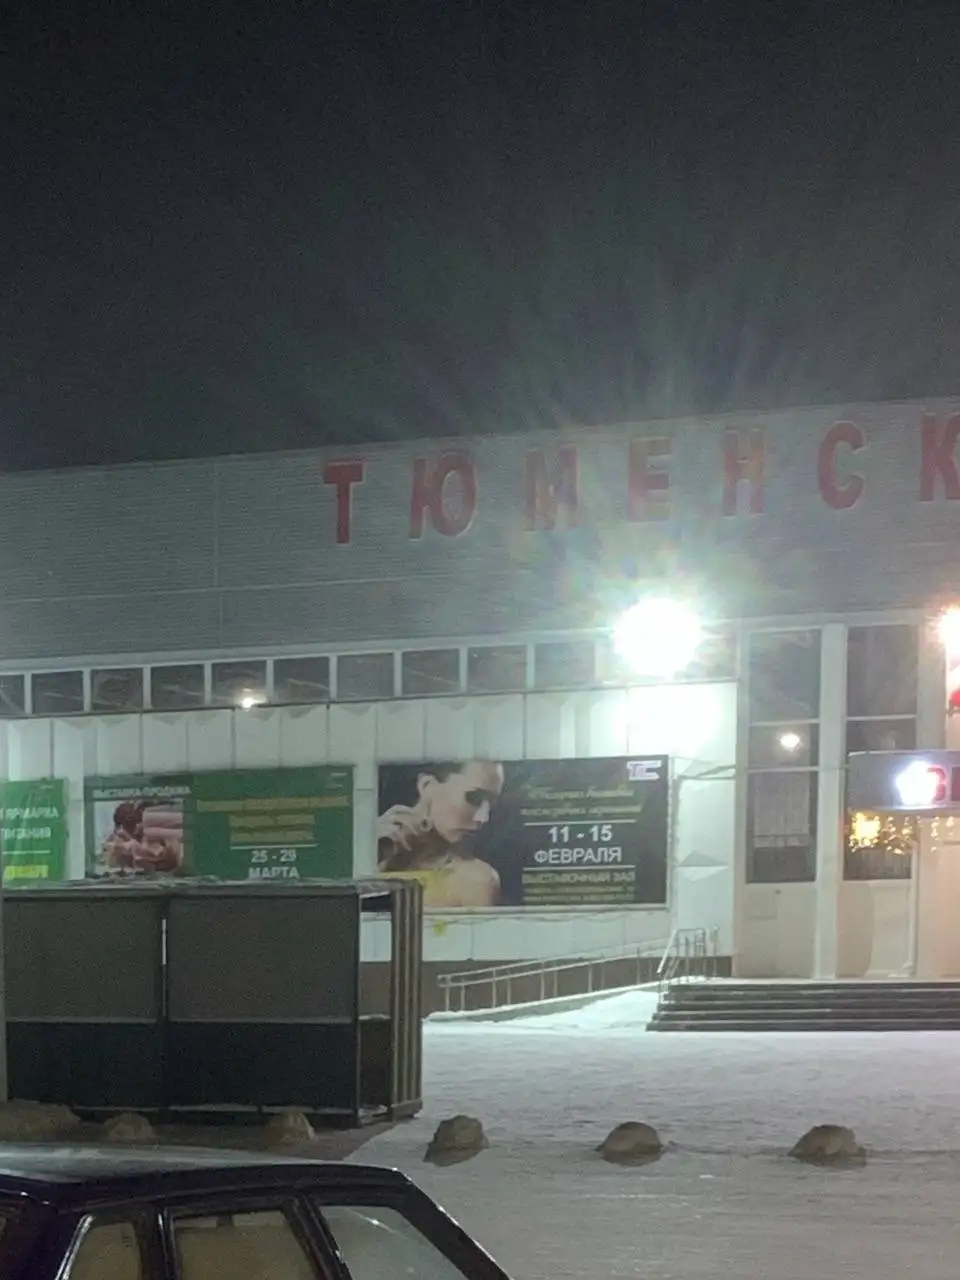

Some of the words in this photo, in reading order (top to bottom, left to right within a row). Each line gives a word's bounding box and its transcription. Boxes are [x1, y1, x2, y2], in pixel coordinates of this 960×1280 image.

[548, 825, 570, 843] 11
[589, 824, 613, 841] 15
[251, 850, 268, 864] 25
[280, 848, 297, 862] 29
[534, 846, 622, 864] ФЕВРАЛЯ
[248, 865, 300, 879] МАРТА
